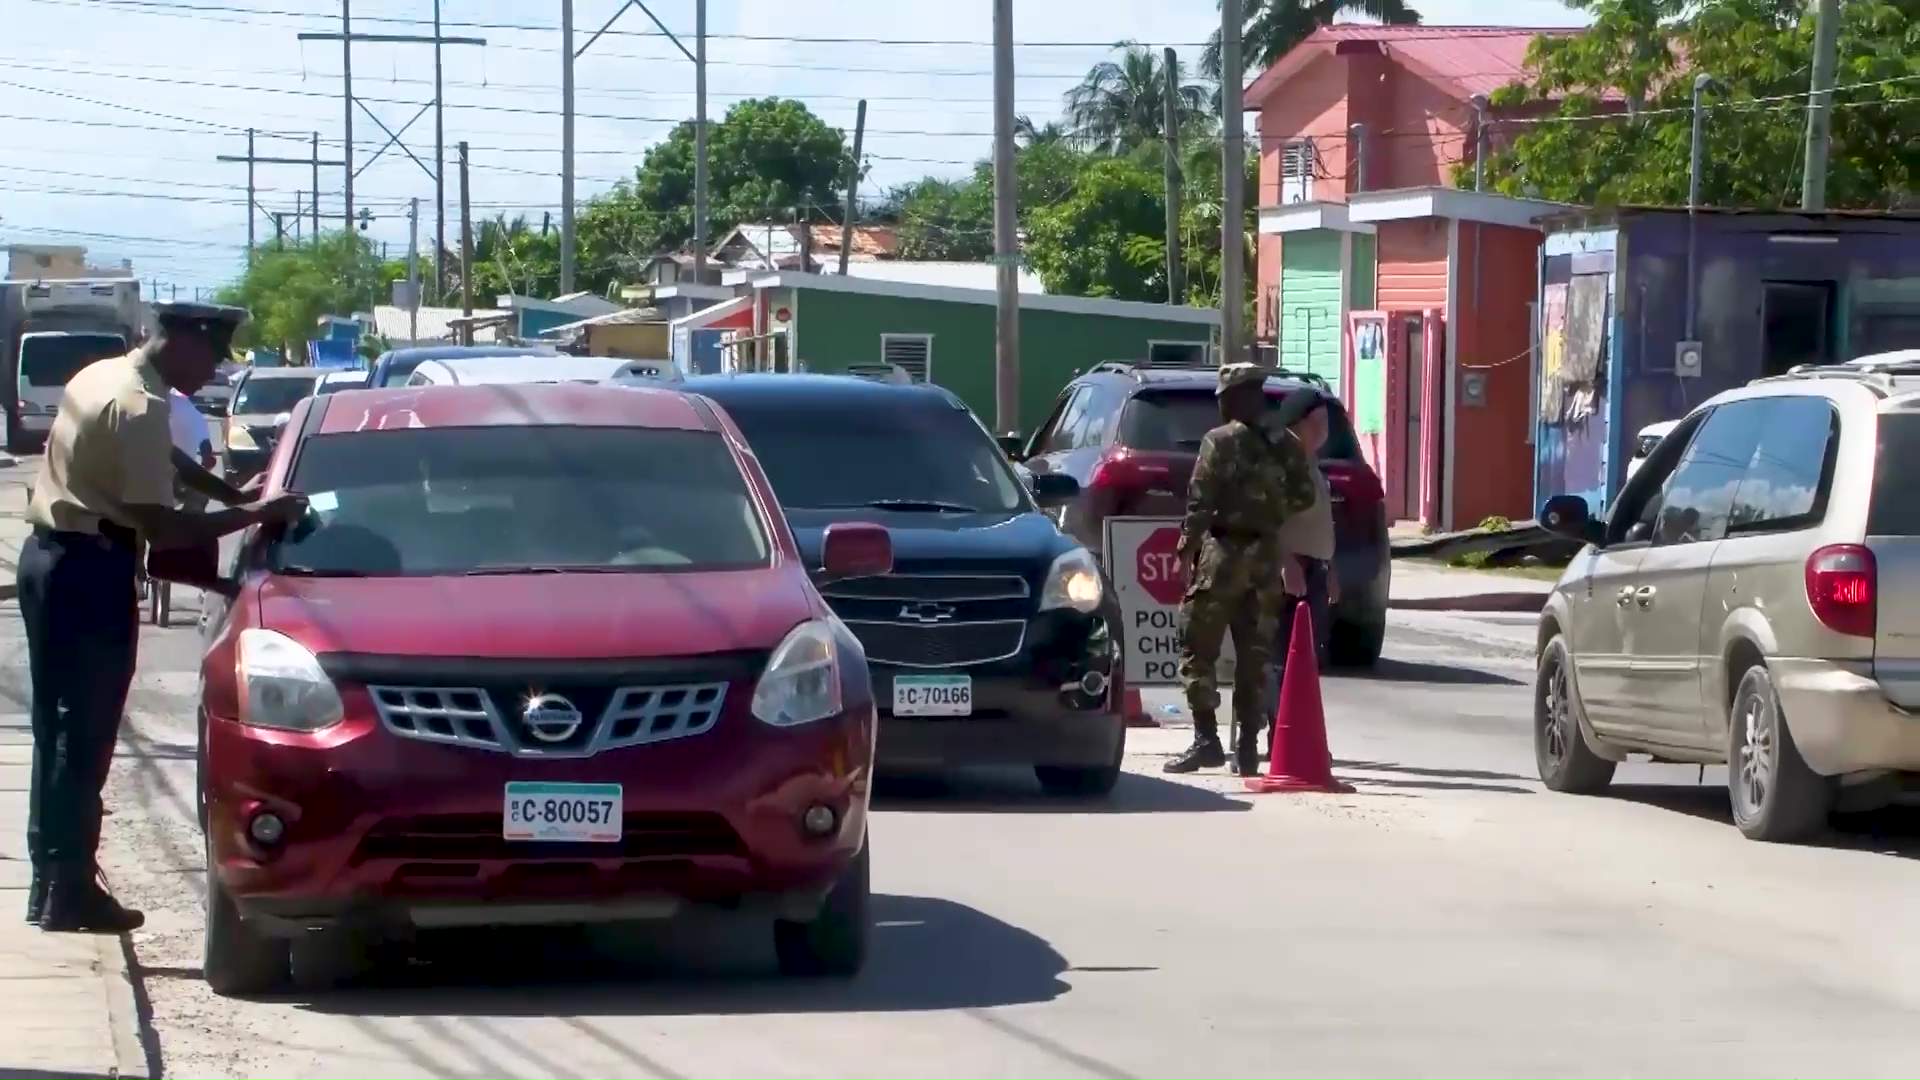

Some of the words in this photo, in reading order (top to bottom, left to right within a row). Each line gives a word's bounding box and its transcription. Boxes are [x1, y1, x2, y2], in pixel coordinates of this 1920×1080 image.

[1141, 553, 1173, 581] ST
[1136, 611, 1177, 628] POL
[1138, 637, 1181, 654] CHE
[1145, 662, 1177, 679] PO
[907, 687, 969, 705] C-70166
[522, 799, 613, 824] C-80057
